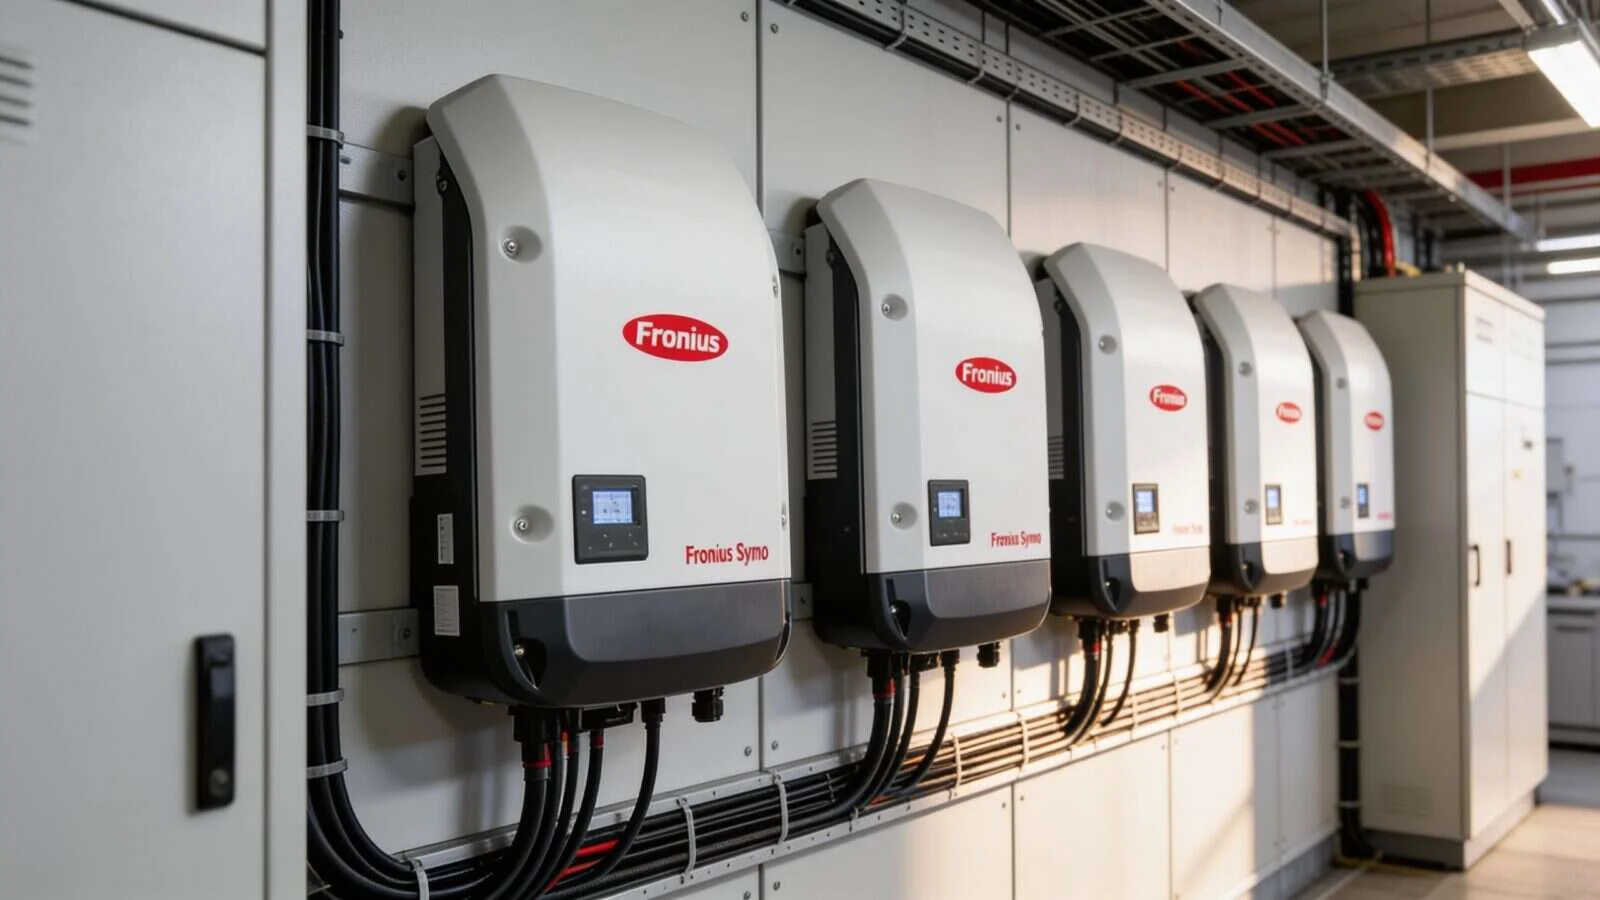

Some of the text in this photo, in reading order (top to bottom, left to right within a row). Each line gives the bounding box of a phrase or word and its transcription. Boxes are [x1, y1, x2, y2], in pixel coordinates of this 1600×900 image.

[636, 321, 720, 353] Fronius
[962, 362, 1013, 387] Fronius
[685, 542, 769, 566] Fronius Symo
